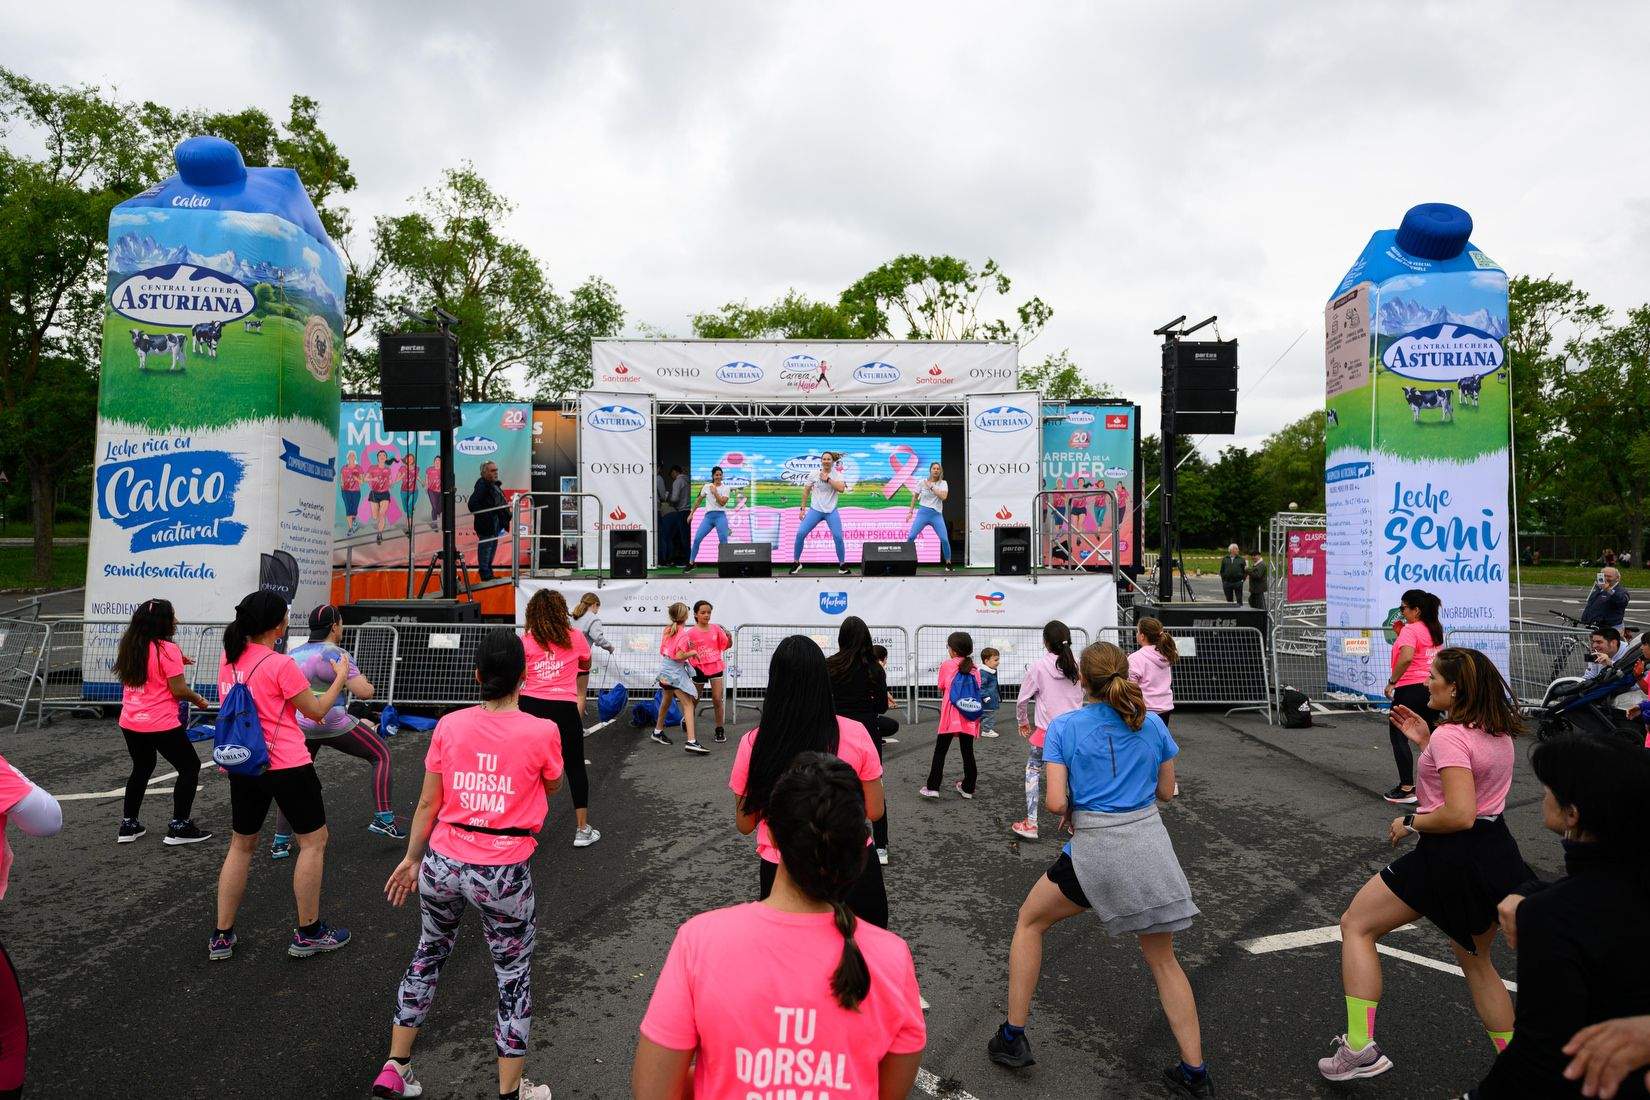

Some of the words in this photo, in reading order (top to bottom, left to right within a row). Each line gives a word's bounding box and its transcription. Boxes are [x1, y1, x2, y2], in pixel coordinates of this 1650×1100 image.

[191, 285, 239, 294] LECHERA
[118, 285, 244, 313] ASTURIANA
[1389, 345, 1498, 368] ASTURIANA
[657, 367, 700, 377] OYSHO
[720, 370, 760, 379] ASTURIANA
[780, 370, 810, 380] Carrera
[856, 370, 898, 380] ASTURIANA
[970, 368, 1012, 378] OYSHO
[602, 375, 641, 383] Santander
[916, 376, 954, 384] Santander
[354, 408, 384, 421] CA
[503, 411, 523, 423] 20
[592, 415, 642, 426] ASTURIANA
[979, 417, 1029, 427] ASTURIANA
[1073, 432, 1088, 443] 20
[104, 440, 138, 461] Leche
[142, 438, 169, 451] rica
[174, 436, 191, 449] en
[459, 442, 496, 452] ASTURIANA
[1043, 452, 1092, 461] ARRERA
[591, 463, 644, 475] OYSHO
[977, 463, 1030, 475] OYSHO
[781, 471, 811, 480] Carre
[105, 463, 225, 519] Calcio
[1388, 481, 1452, 517] Leche
[151, 521, 220, 543] natural
[594, 522, 642, 531] Santander
[1383, 508, 1502, 555] semi
[824, 529, 865, 539] ACIÓN
[868, 529, 924, 539] PSICOLÓGA
[104, 561, 217, 579] semidesnatada
[1384, 553, 1504, 584] desnatada
[1442, 607, 1495, 619] INGREDIENTES:
[476, 753, 497, 772] TU
[453, 771, 516, 795] DORSAL
[460, 792, 505, 814] SUMA
[774, 1006, 816, 1045] TU
[735, 1047, 851, 1090] DORSAL
